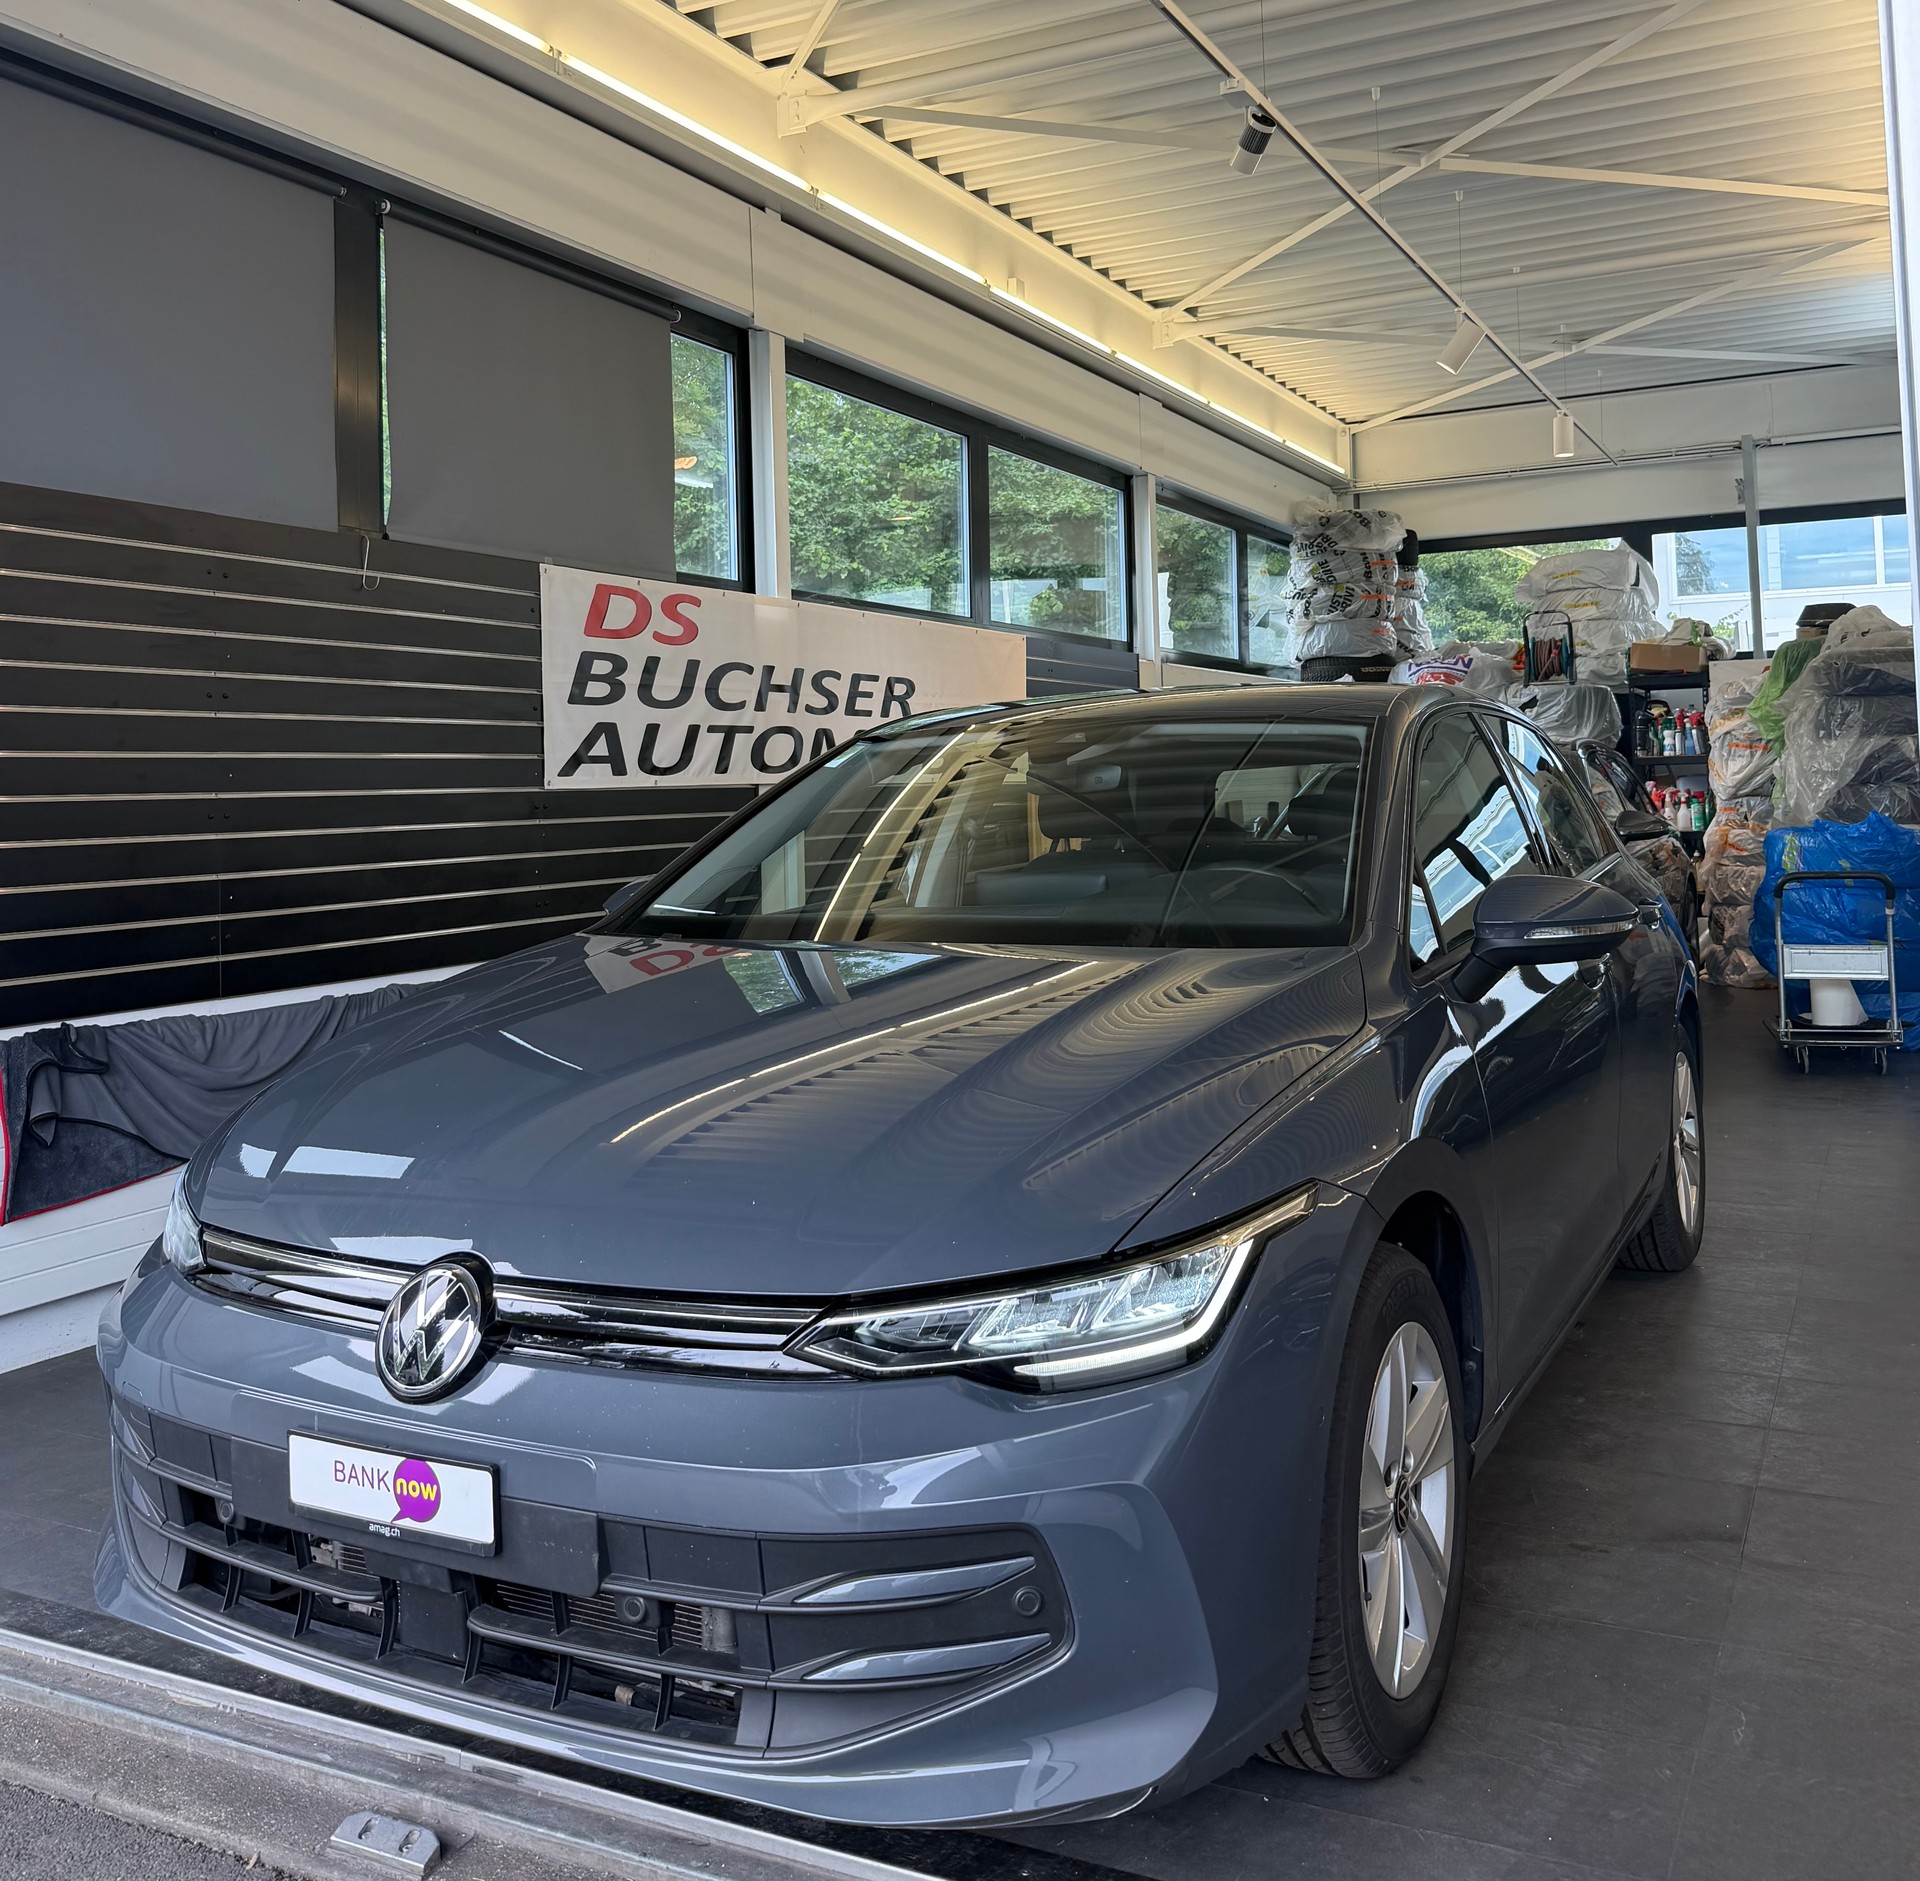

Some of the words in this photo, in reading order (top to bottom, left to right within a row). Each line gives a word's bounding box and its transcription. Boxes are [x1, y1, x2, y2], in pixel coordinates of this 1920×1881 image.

[583, 583, 701, 646] DS
[567, 651, 917, 719] BUCHSER
[334, 1459, 391, 1492] BANK
[395, 1477, 438, 1501] now
[368, 1523, 401, 1537] amag.ch
